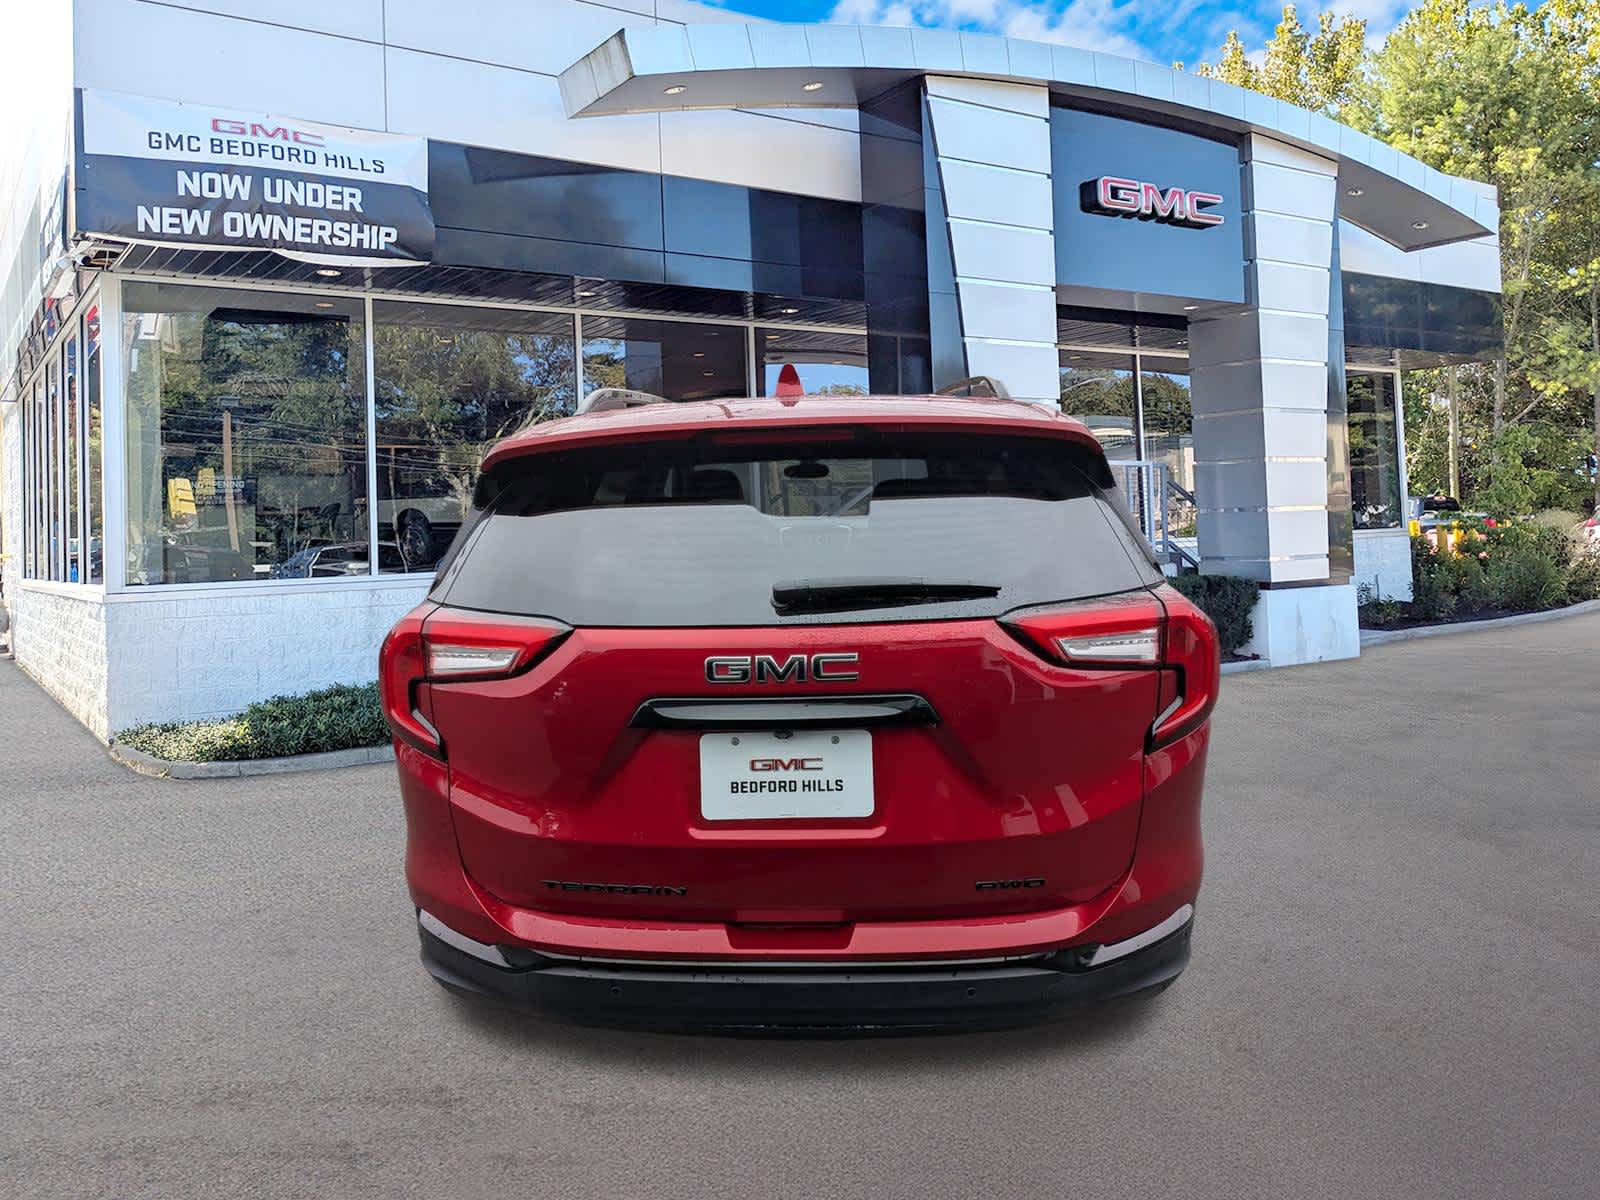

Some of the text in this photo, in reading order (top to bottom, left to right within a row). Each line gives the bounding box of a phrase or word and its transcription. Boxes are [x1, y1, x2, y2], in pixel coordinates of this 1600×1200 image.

[211, 118, 326, 147] GMC
[148, 131, 385, 174] GMC BEDFORD HILLS
[177, 170, 364, 213] NOW UNDER
[1098, 175, 1225, 225] GMC
[136, 206, 398, 250] NEW OWNERSHIP
[704, 652, 858, 684] GMC
[750, 757, 823, 772] GMC
[730, 779, 844, 794] BEDFORD HILLS
[539, 880, 688, 896] TERRAIN
[975, 878, 1045, 890] AWD
